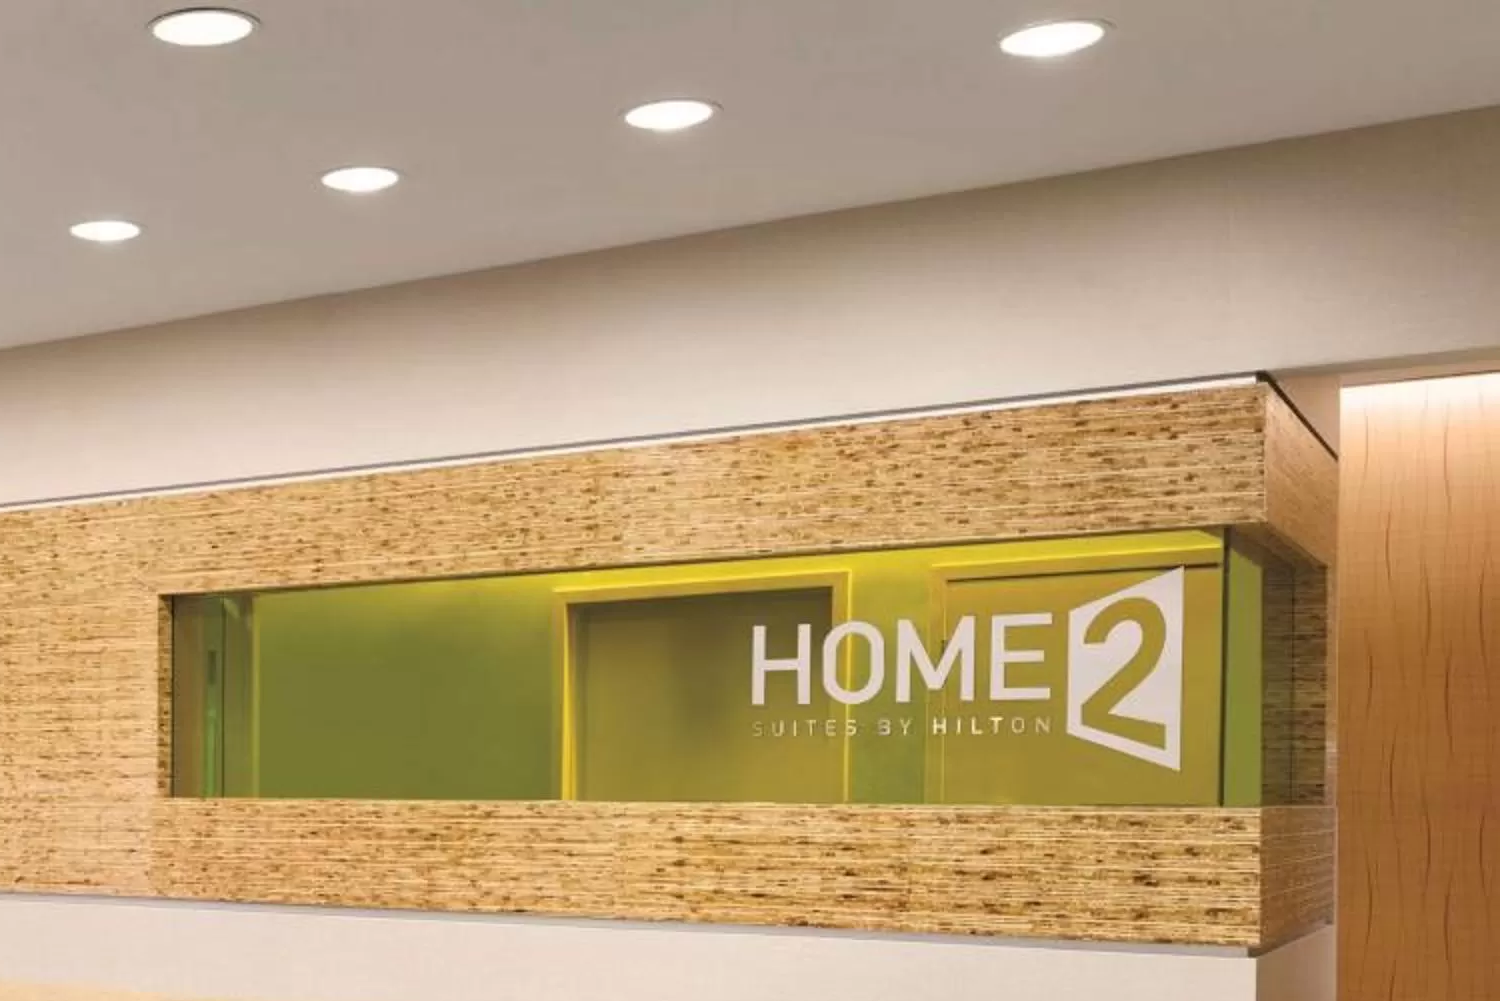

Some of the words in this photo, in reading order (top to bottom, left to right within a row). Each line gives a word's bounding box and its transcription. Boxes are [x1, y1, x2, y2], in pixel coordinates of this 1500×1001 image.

[752, 719, 858, 738] SUITES
[878, 719, 913, 737] BY
[932, 716, 1053, 736] HILTON
